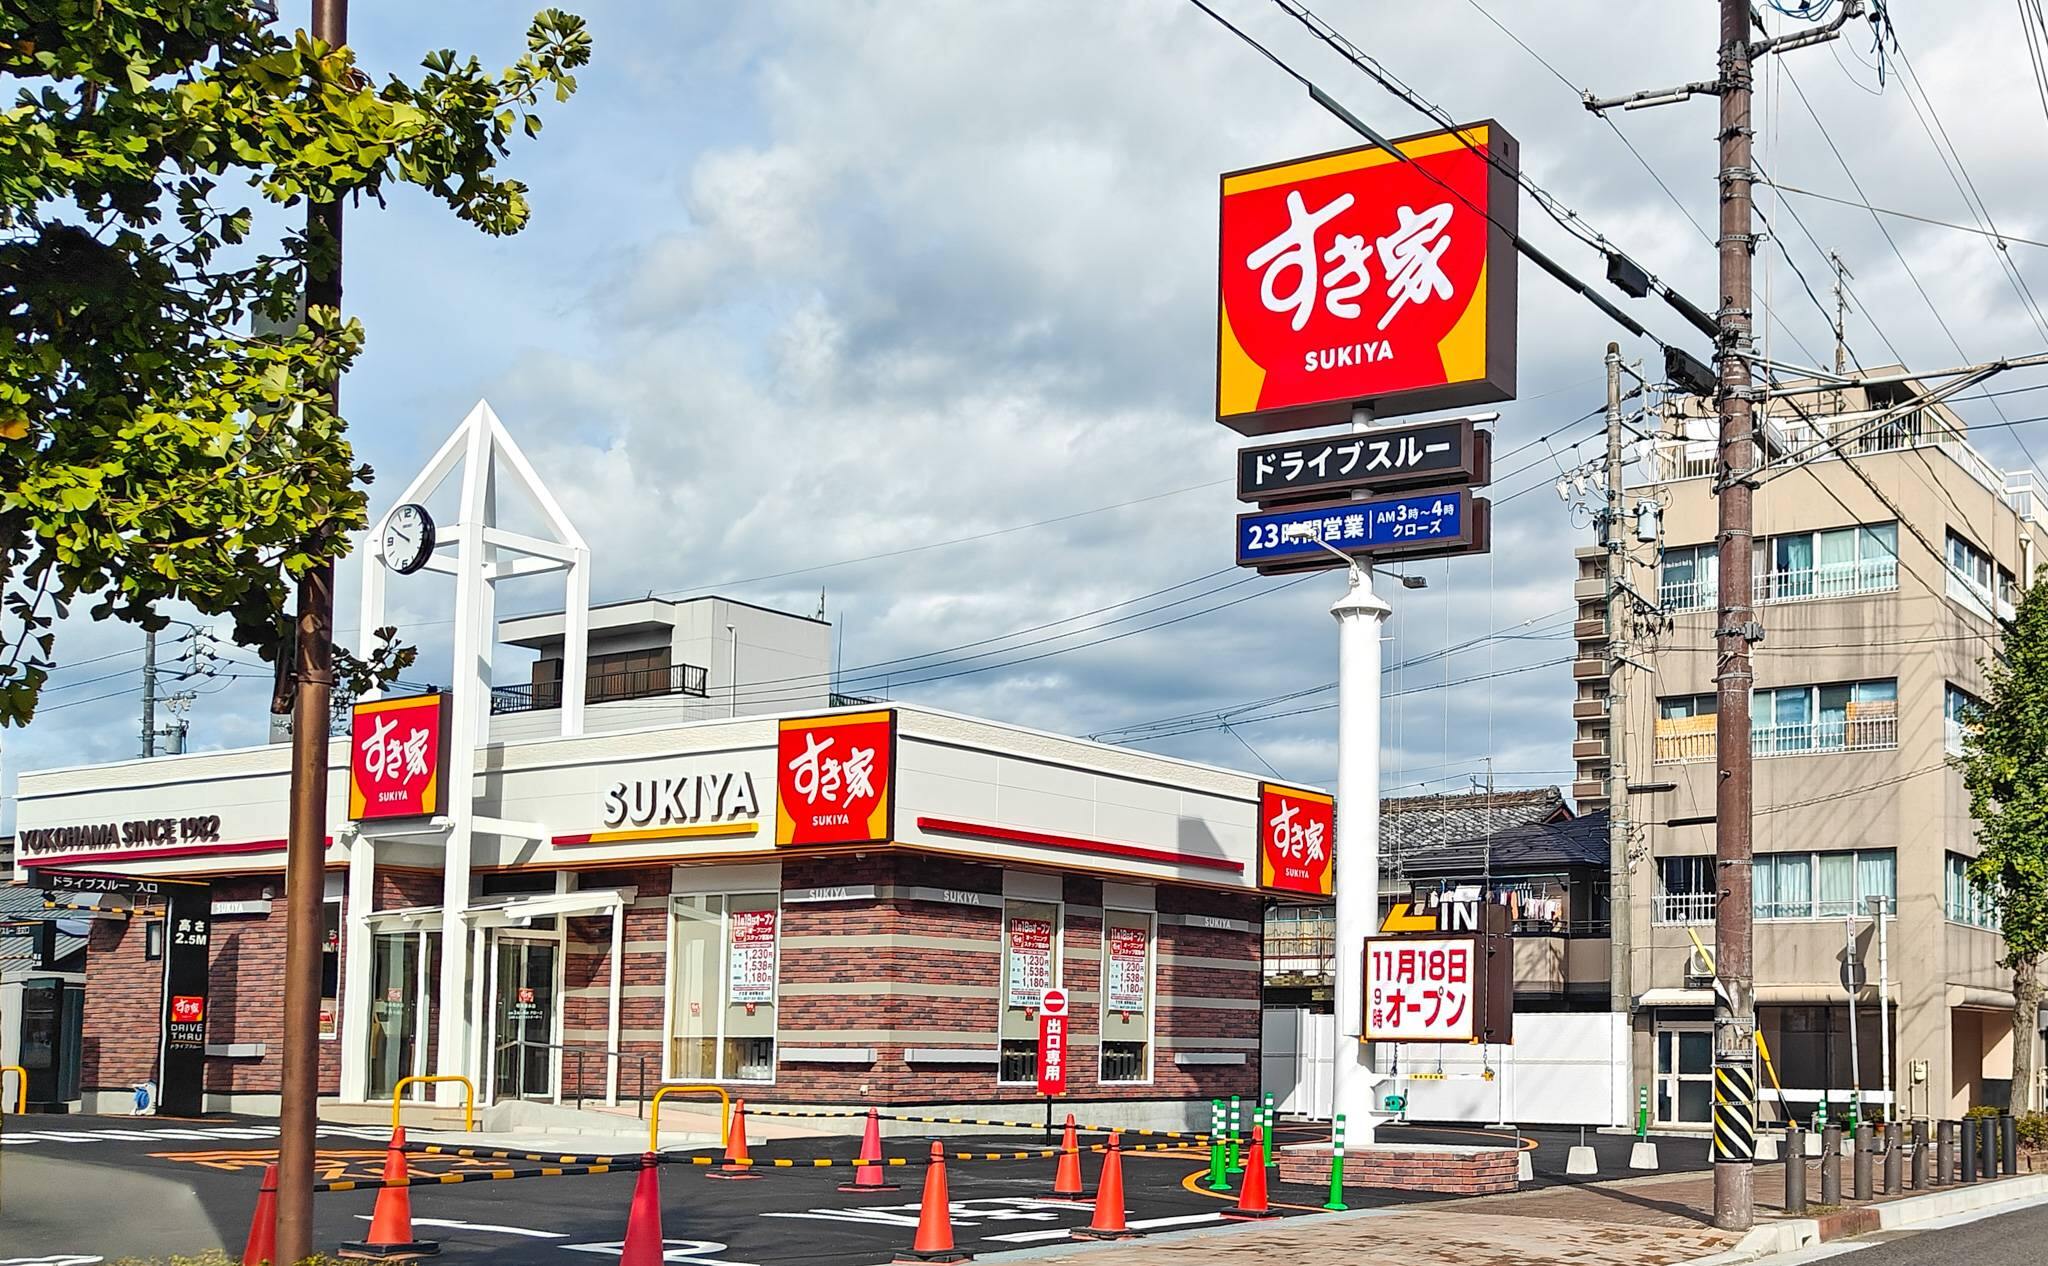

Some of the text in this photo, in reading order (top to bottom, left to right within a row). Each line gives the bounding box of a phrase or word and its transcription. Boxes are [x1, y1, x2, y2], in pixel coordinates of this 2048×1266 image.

[1246, 190, 1454, 331] すき家
[1305, 340, 1393, 371] SUKIYA
[1255, 436, 1450, 485] ドライブスルー
[1248, 514, 1364, 550] 23時間営業
[1392, 519, 1442, 538] クローズ
[387, 537, 394, 547] 9
[361, 715, 430, 785] すき家
[788, 732, 875, 809] すき家
[379, 790, 408, 802] SUKIYA
[603, 771, 760, 829] SUKIYA
[812, 814, 850, 827] SUKIYA
[1270, 799, 1325, 866] すき家
[19, 815, 221, 855] YOKOHAMA SINCE 1982
[53, 876, 158, 893] ドライブスルー 入口
[1285, 867, 1309, 879] SUKIYA
[809, 888, 847, 900] SUKIYA
[943, 890, 980, 905] SUKIYA
[178, 919, 205, 932] 高さ
[1204, 917, 1232, 929] SUKIYA
[1440, 902, 1478, 931] IN
[175, 933, 207, 946] 2.5M
[1372, 949, 1468, 985] 11月18日
[1386, 986, 1467, 1028] オープン
[171, 1024, 203, 1032] DRIVE
[171, 1033, 203, 1041] THRU
[1045, 1018, 1061, 1081] 出口専用
